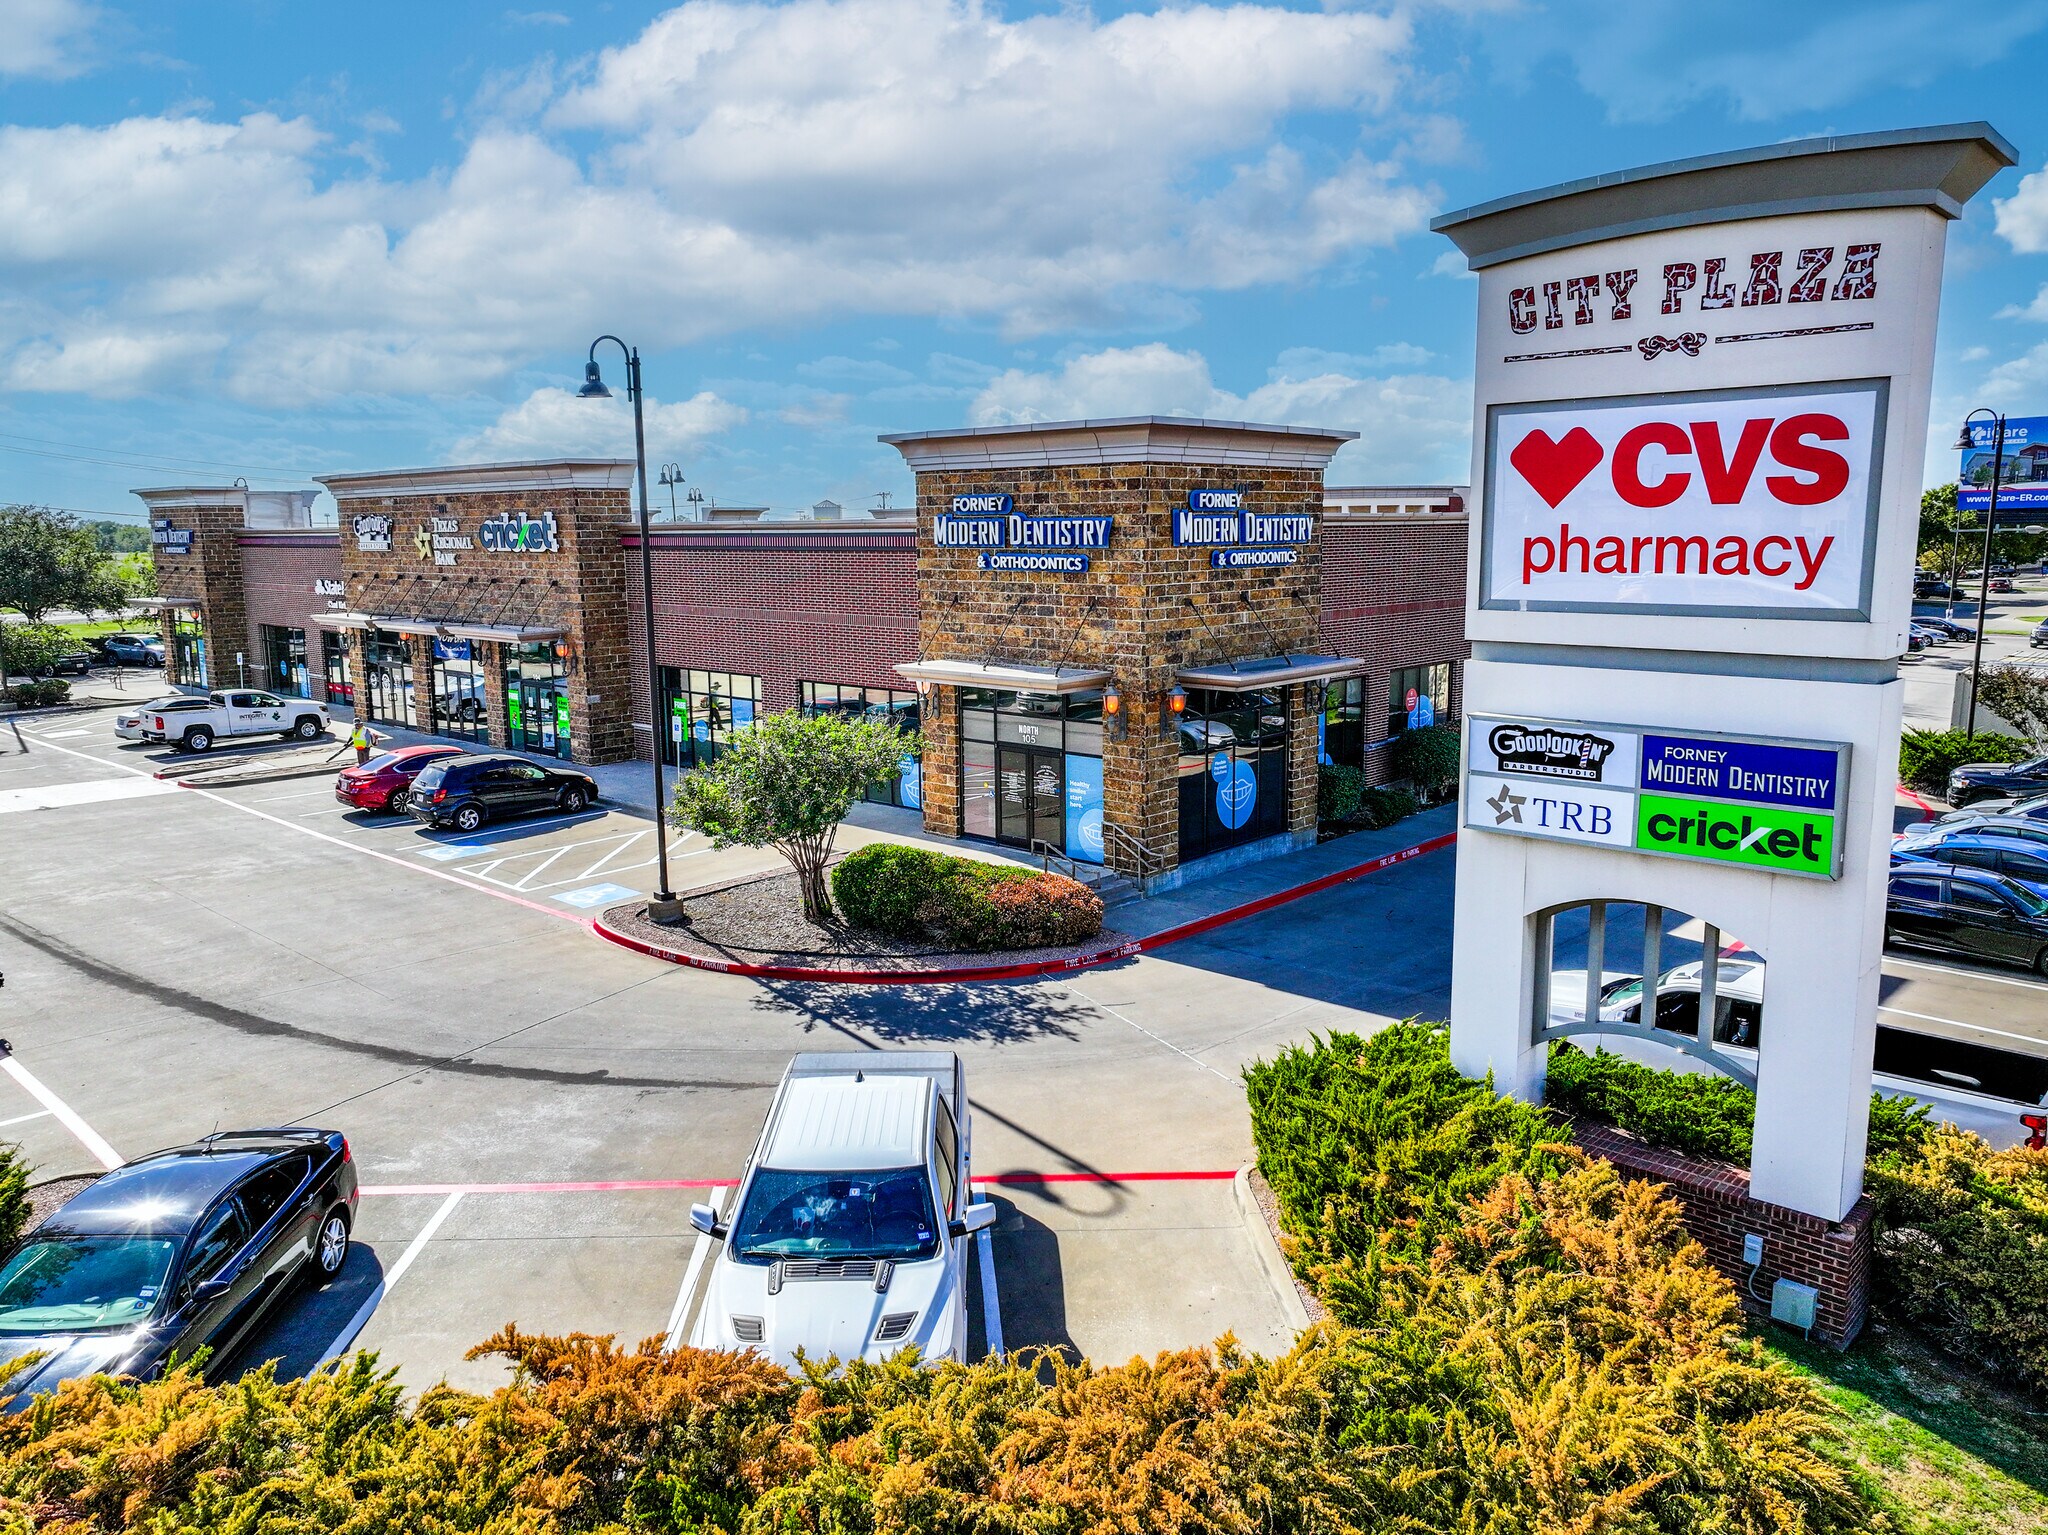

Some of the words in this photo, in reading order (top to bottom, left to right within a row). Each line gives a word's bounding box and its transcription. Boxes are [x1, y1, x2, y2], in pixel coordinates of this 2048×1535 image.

[1508, 269, 1638, 336] CITY
[1660, 242, 1882, 316] PLAZA
[1611, 413, 1851, 508] CVS
[953, 496, 1004, 512] FORNEY
[1200, 492, 1243, 508] FORNEY
[431, 517, 459, 533] TEXAS
[479, 511, 560, 553] cricket
[933, 515, 999, 546] MODERN
[1009, 515, 1107, 546] DENTISTRY
[1179, 511, 1239, 543] MODERN
[1245, 512, 1314, 542] DENTISTRY
[432, 534, 474, 549] REGIONAL
[434, 550, 457, 566] BANK
[977, 555, 986, 568] &
[990, 555, 1082, 571] ORTHODONTICS
[1218, 554, 1227, 566] &
[1230, 550, 1298, 566] ORTHODONTICS
[1522, 523, 1835, 591] pharmacy
[1018, 724, 1039, 735] NORTH
[1022, 734, 1036, 744] 105
[1665, 746, 1728, 763] FORNEY
[1504, 762, 1549, 773] BARBER
[1552, 767, 1595, 778] STUDIO
[1069, 780, 1090, 789] Healthy
[1647, 758, 1719, 788] MODERN
[1728, 766, 1830, 799] DENTISTRY
[1533, 797, 1612, 835] TRB
[1647, 810, 1823, 862] cricket
[649, 947, 661, 957] FIRE
[662, 950, 677, 962] LANE
[1120, 943, 1142, 956] PARKING
[700, 960, 729, 972] PARKING
[1064, 958, 1080, 968] FIRE
[1081, 954, 1099, 965] LANE
